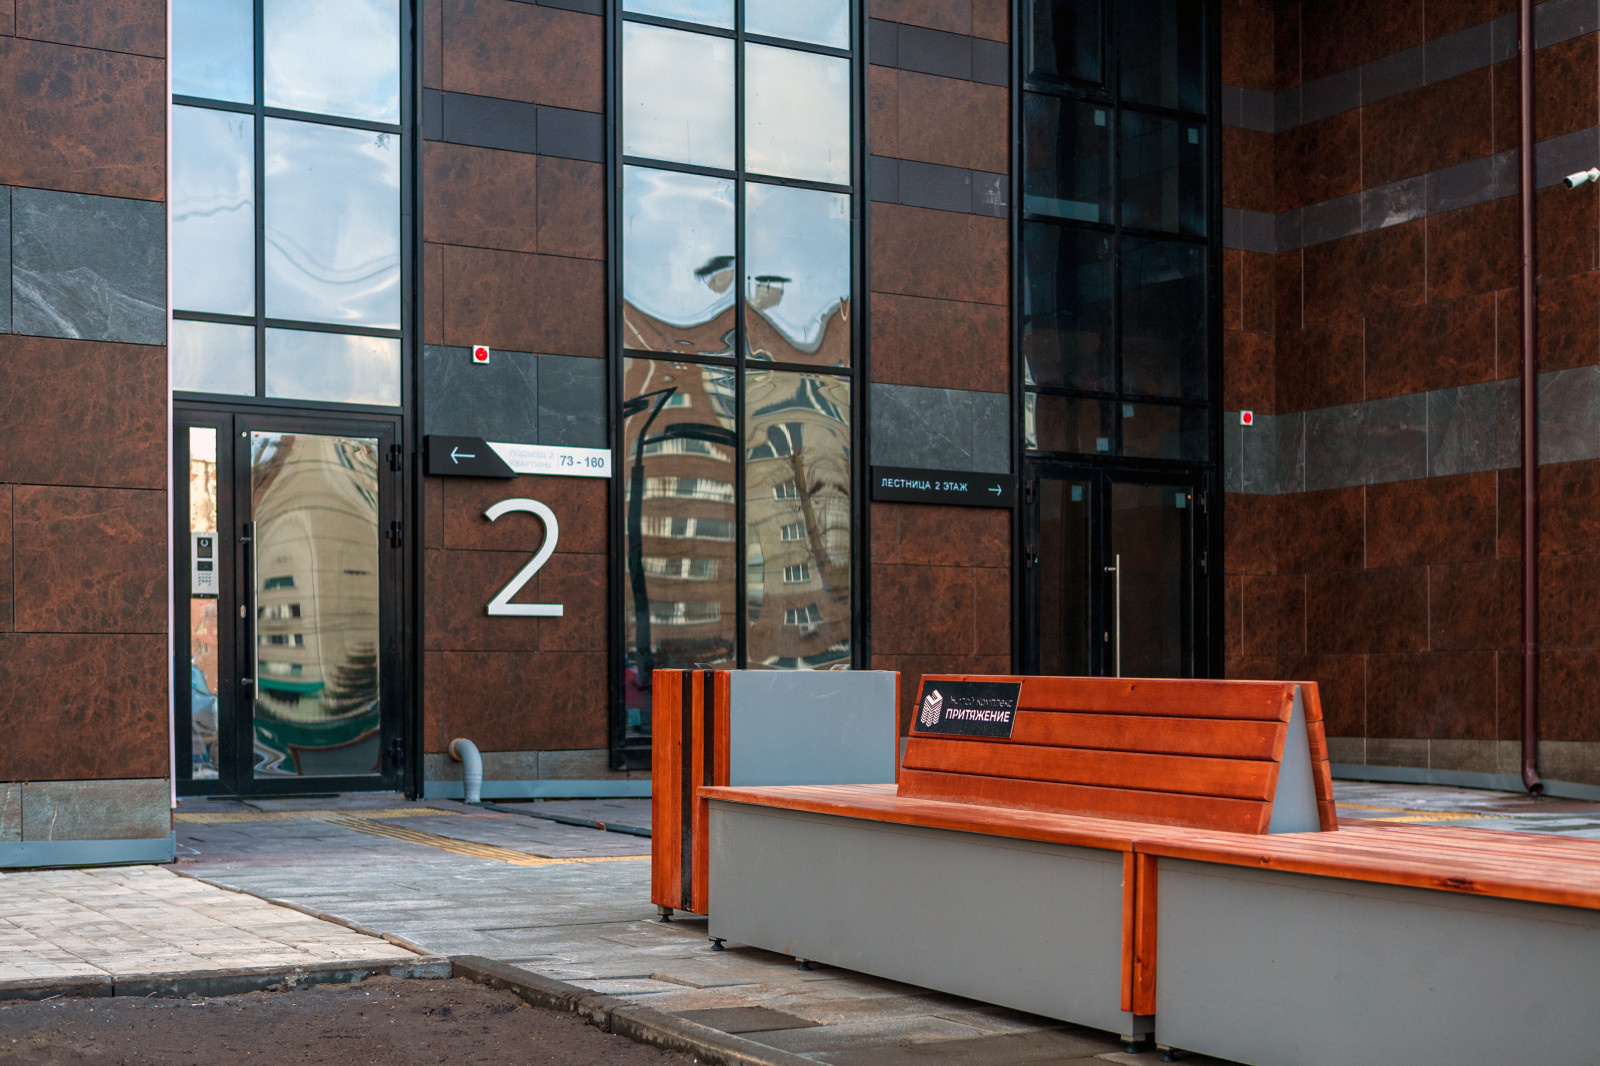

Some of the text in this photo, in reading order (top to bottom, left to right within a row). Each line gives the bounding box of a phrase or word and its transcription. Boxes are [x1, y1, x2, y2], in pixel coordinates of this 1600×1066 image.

[549, 451, 554, 459] 2
[560, 455, 574, 467] 73
[584, 457, 605, 469] 160
[509, 460, 552, 469] КВАРТИРЫ
[881, 478, 968, 492] ЛЕСТНИЦА 2 ЭТАЖ
[484, 498, 563, 617] 2
[945, 708, 1011, 723] ПРИТЯЖЕНИЕ
